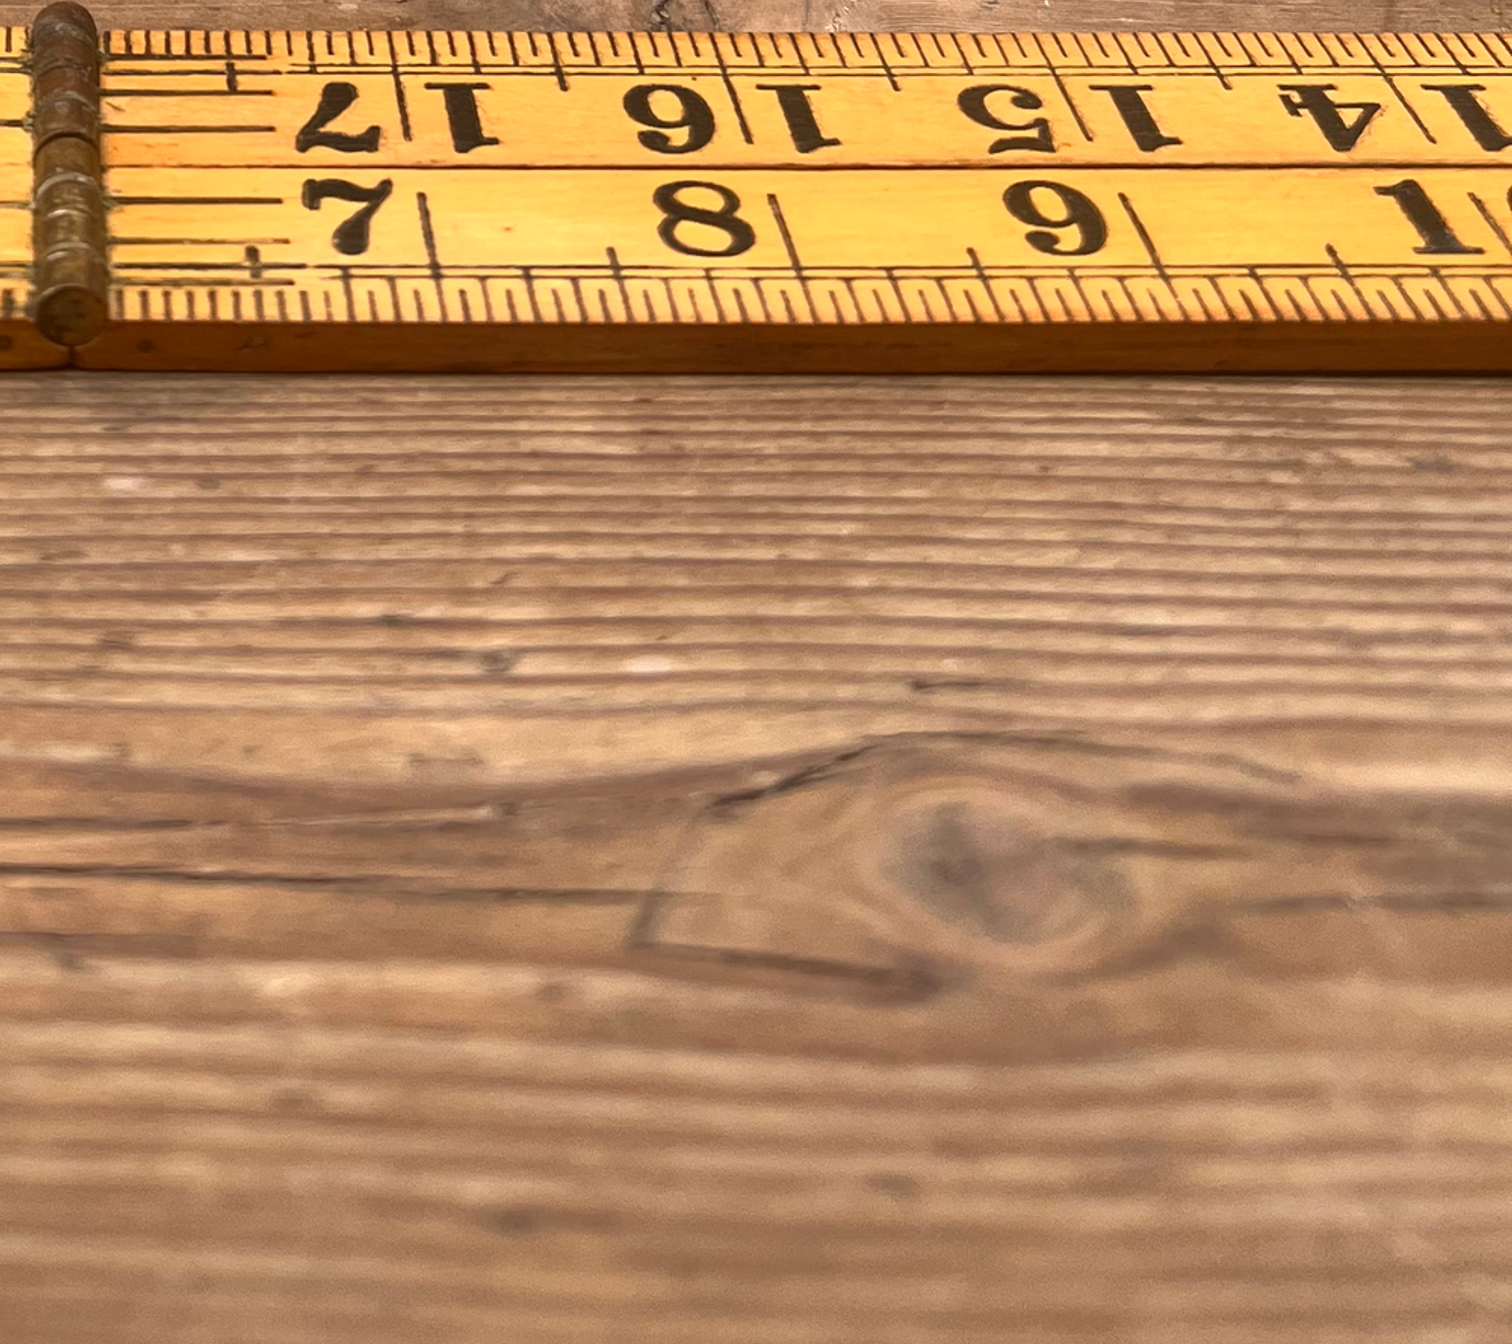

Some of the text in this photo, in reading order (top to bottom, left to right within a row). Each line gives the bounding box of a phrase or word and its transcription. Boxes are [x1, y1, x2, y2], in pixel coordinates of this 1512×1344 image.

[301, 178, 393, 256] 7
[653, 180, 755, 257] 8
[1003, 180, 1108, 256] 9
